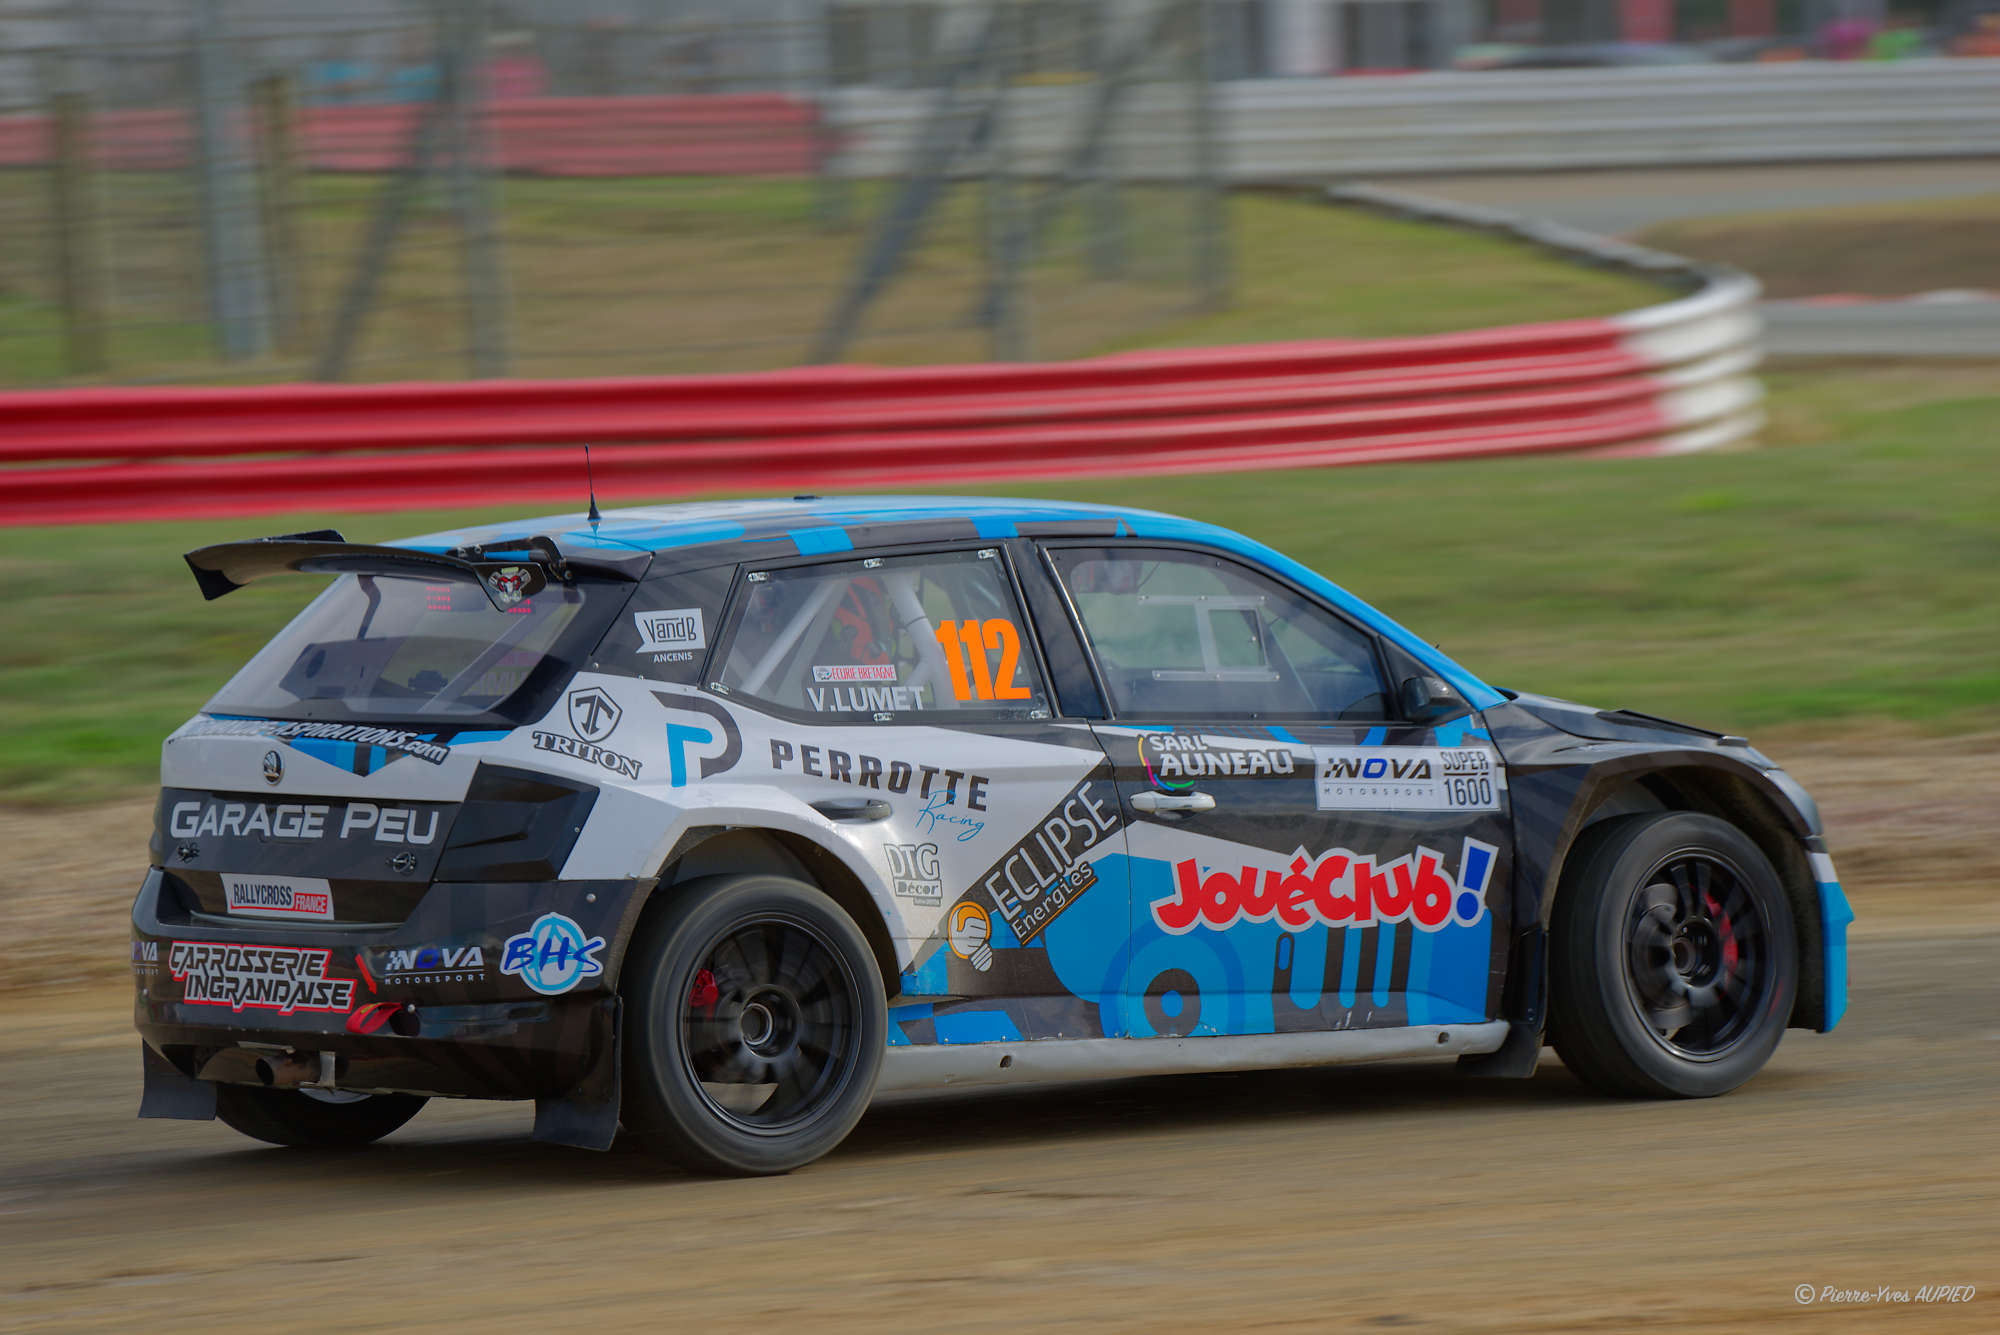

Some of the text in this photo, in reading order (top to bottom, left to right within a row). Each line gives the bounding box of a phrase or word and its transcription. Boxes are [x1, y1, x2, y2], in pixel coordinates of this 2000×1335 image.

[653, 650, 694, 664] ANCENIS
[935, 618, 1032, 700] 112
[858, 665, 896, 680] BRETAGNE
[532, 731, 642, 780] TRITON
[1149, 735, 1209, 751] SARL
[1159, 751, 1295, 777] AUNEAU
[1440, 751, 1489, 771] SUPER
[770, 738, 989, 812] PERROTTE
[1324, 787, 1434, 796] MOTORSPORT
[1444, 778, 1492, 805] 1600
[170, 801, 439, 845] GARAGE PEU
[915, 790, 985, 842] Racing
[883, 842, 940, 881] DTG
[984, 781, 1117, 921] ECLIPSE
[233, 883, 292, 906] RALLYCROSS
[897, 881, 939, 895] Décor
[1011, 861, 1094, 939] Energies
[295, 894, 328, 913] FRANCE
[170, 945, 327, 980] CARROSSERIE
[186, 975, 351, 1008] INGRANDAISE
[384, 973, 485, 985] MOTORSPORT
